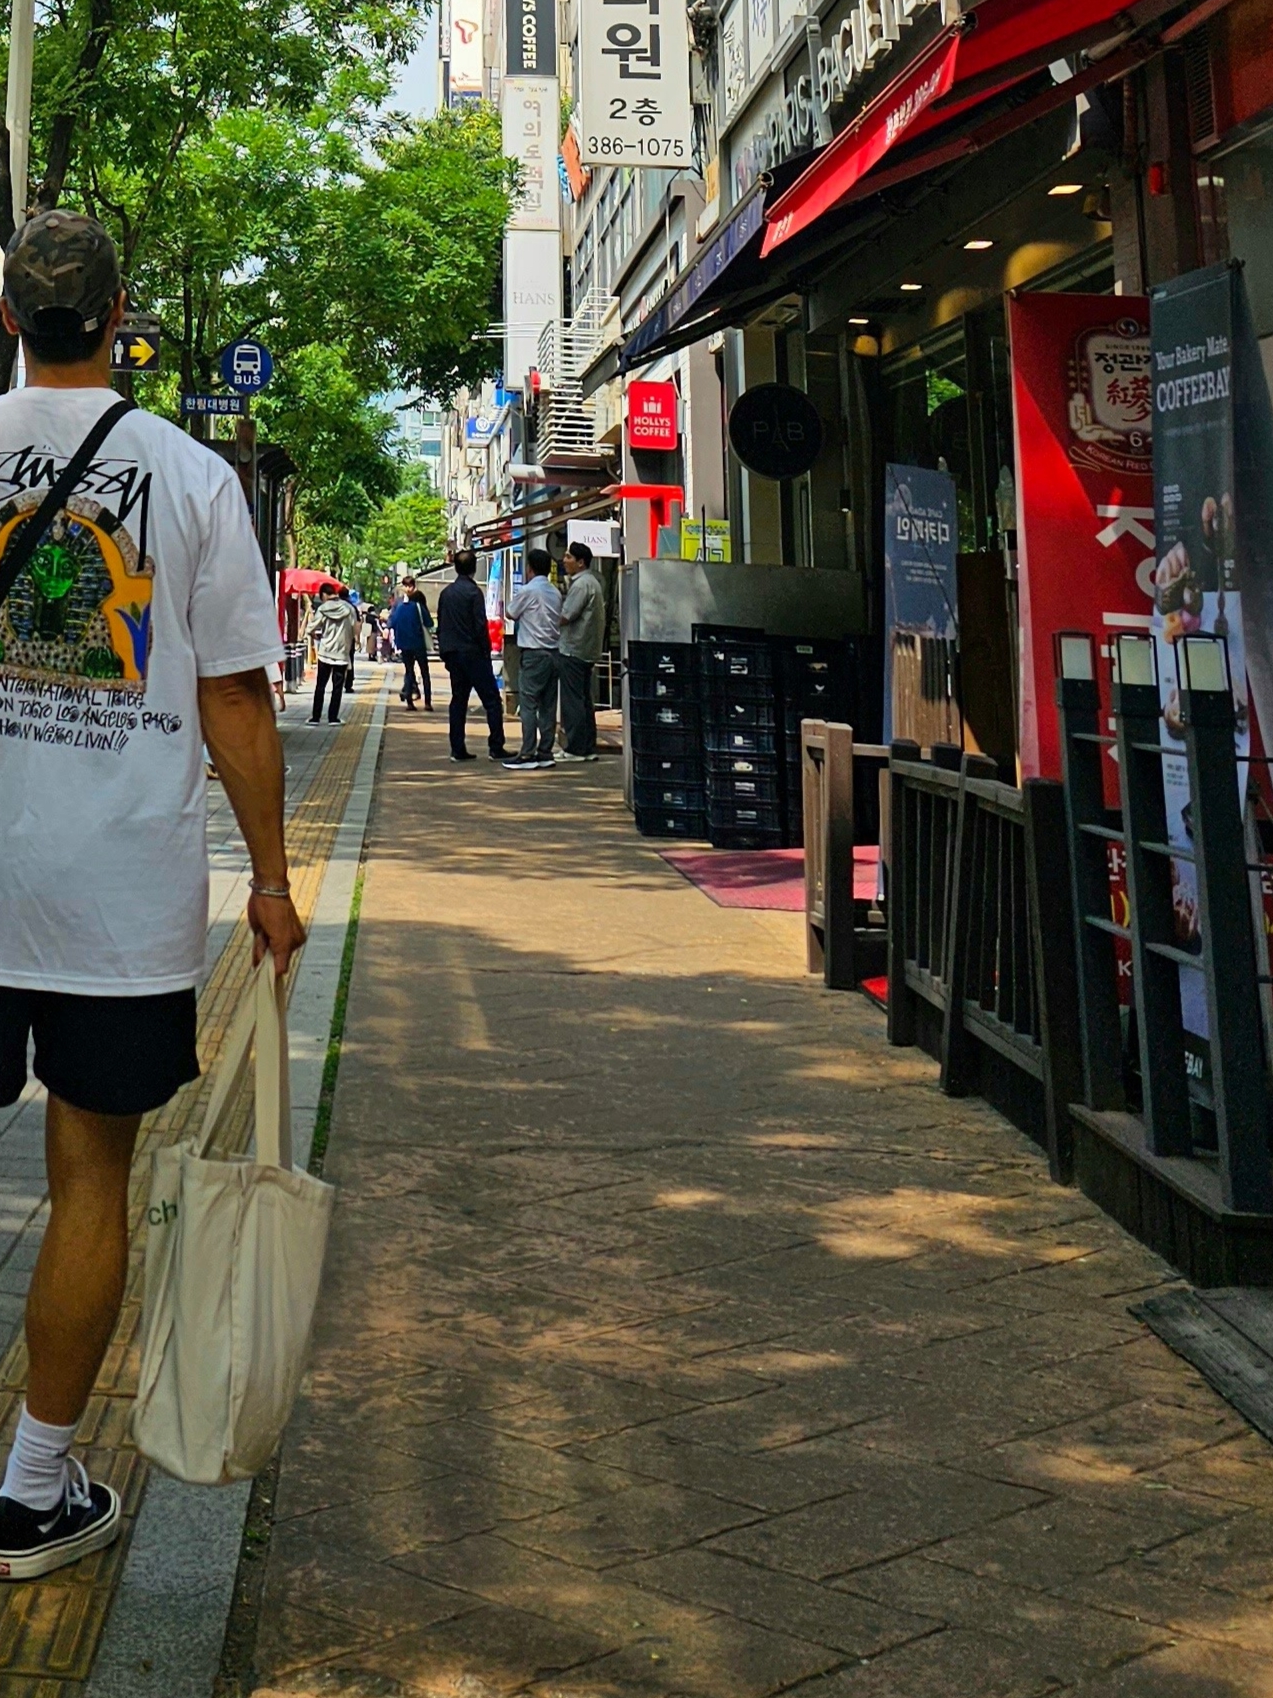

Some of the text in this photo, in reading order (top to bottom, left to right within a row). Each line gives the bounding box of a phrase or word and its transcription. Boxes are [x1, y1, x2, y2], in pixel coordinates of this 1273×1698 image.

[522, 14, 537, 70] COFFEE
[609, 97, 663, 127] 2층
[588, 136, 684, 158] 386-1075
[513, 290, 555, 306] HANS
[1176, 343, 1206, 367] Bakery
[234, 375, 261, 385] BUS
[1156, 365, 1231, 413] COFFEEBAY
[634, 415, 671, 427] HOLLYS
[634, 427, 671, 438] COFFEE
[1085, 444, 1126, 469] KOREAN
[1126, 457, 1149, 471] RED
[583, 534, 608, 545] HANS
